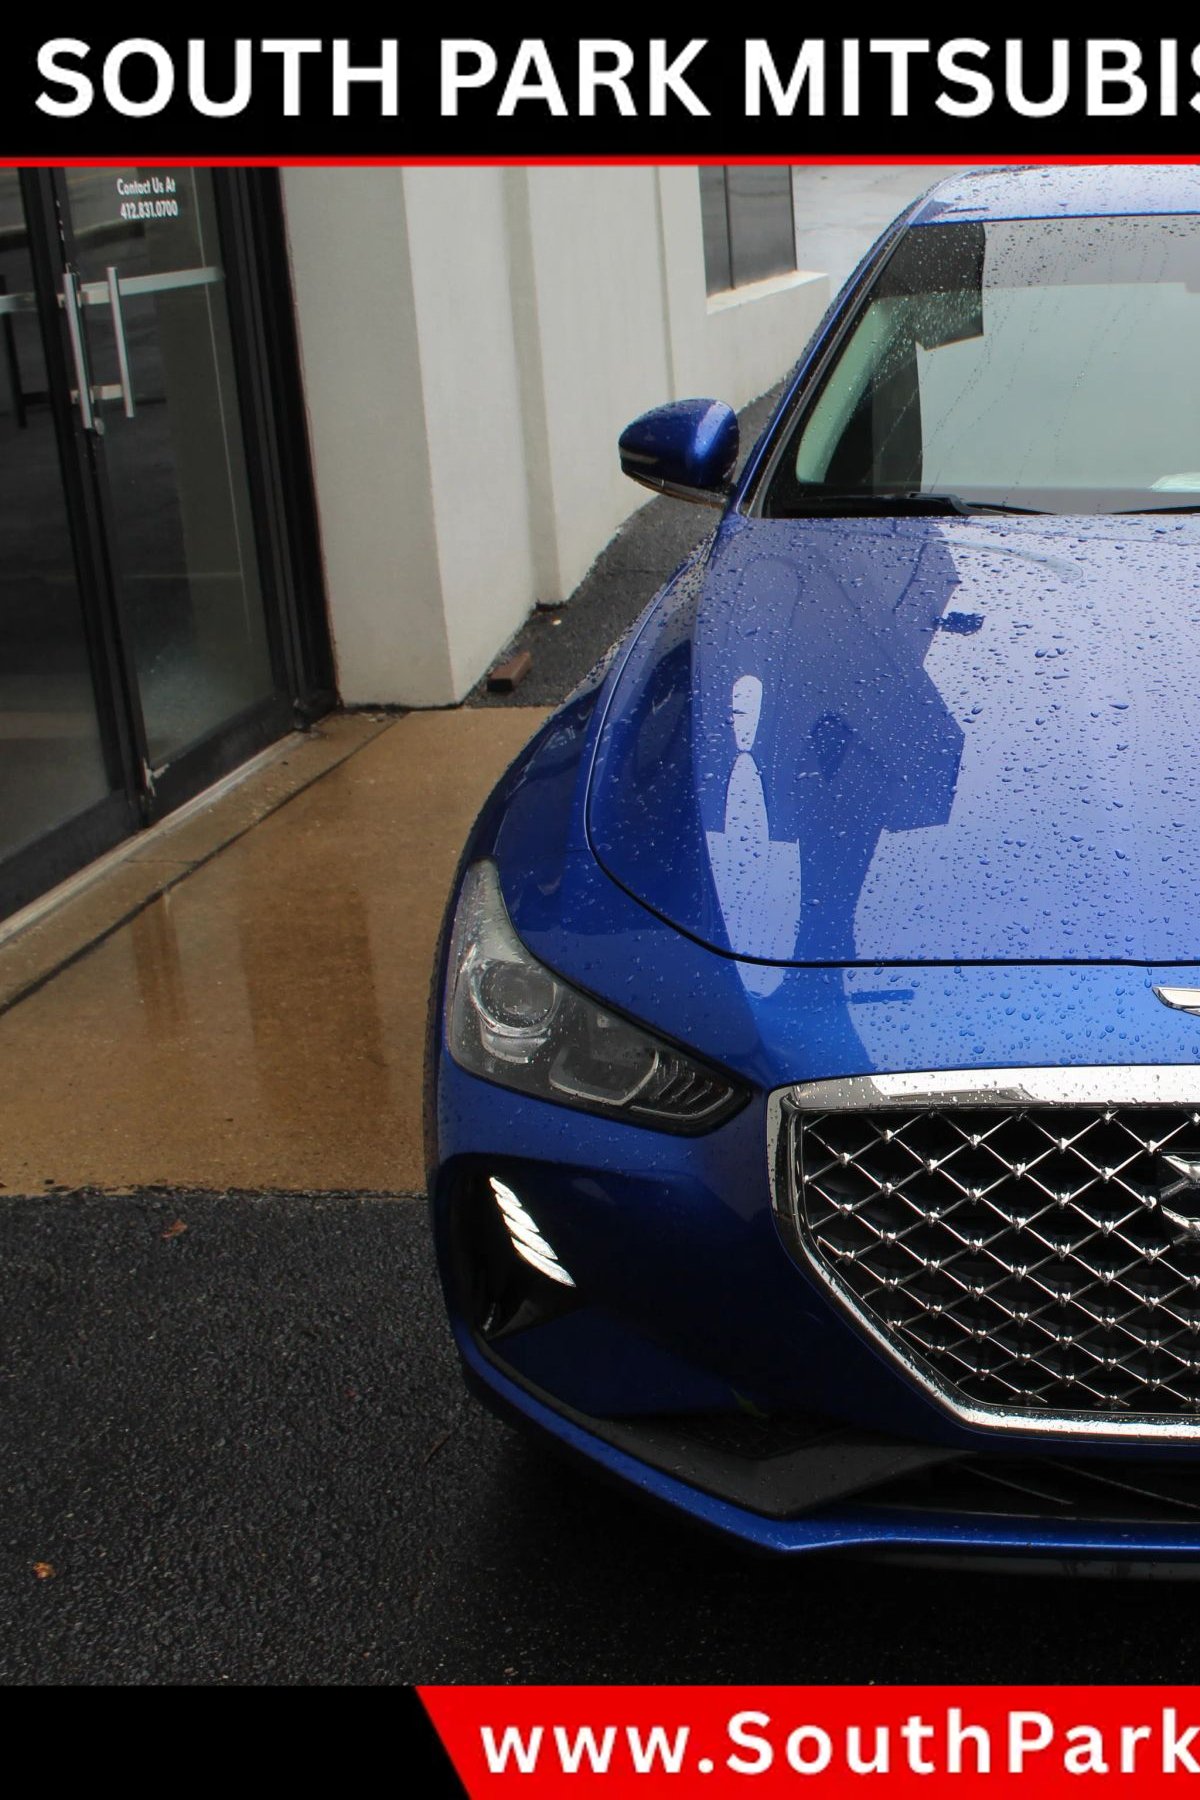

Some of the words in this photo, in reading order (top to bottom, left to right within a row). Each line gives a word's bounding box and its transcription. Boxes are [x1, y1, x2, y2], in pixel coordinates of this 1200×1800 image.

[117, 178, 150, 195] Contact
[151, 177, 164, 193] Us
[165, 176, 176, 192] At
[120, 200, 178, 219] 412.831.0700
